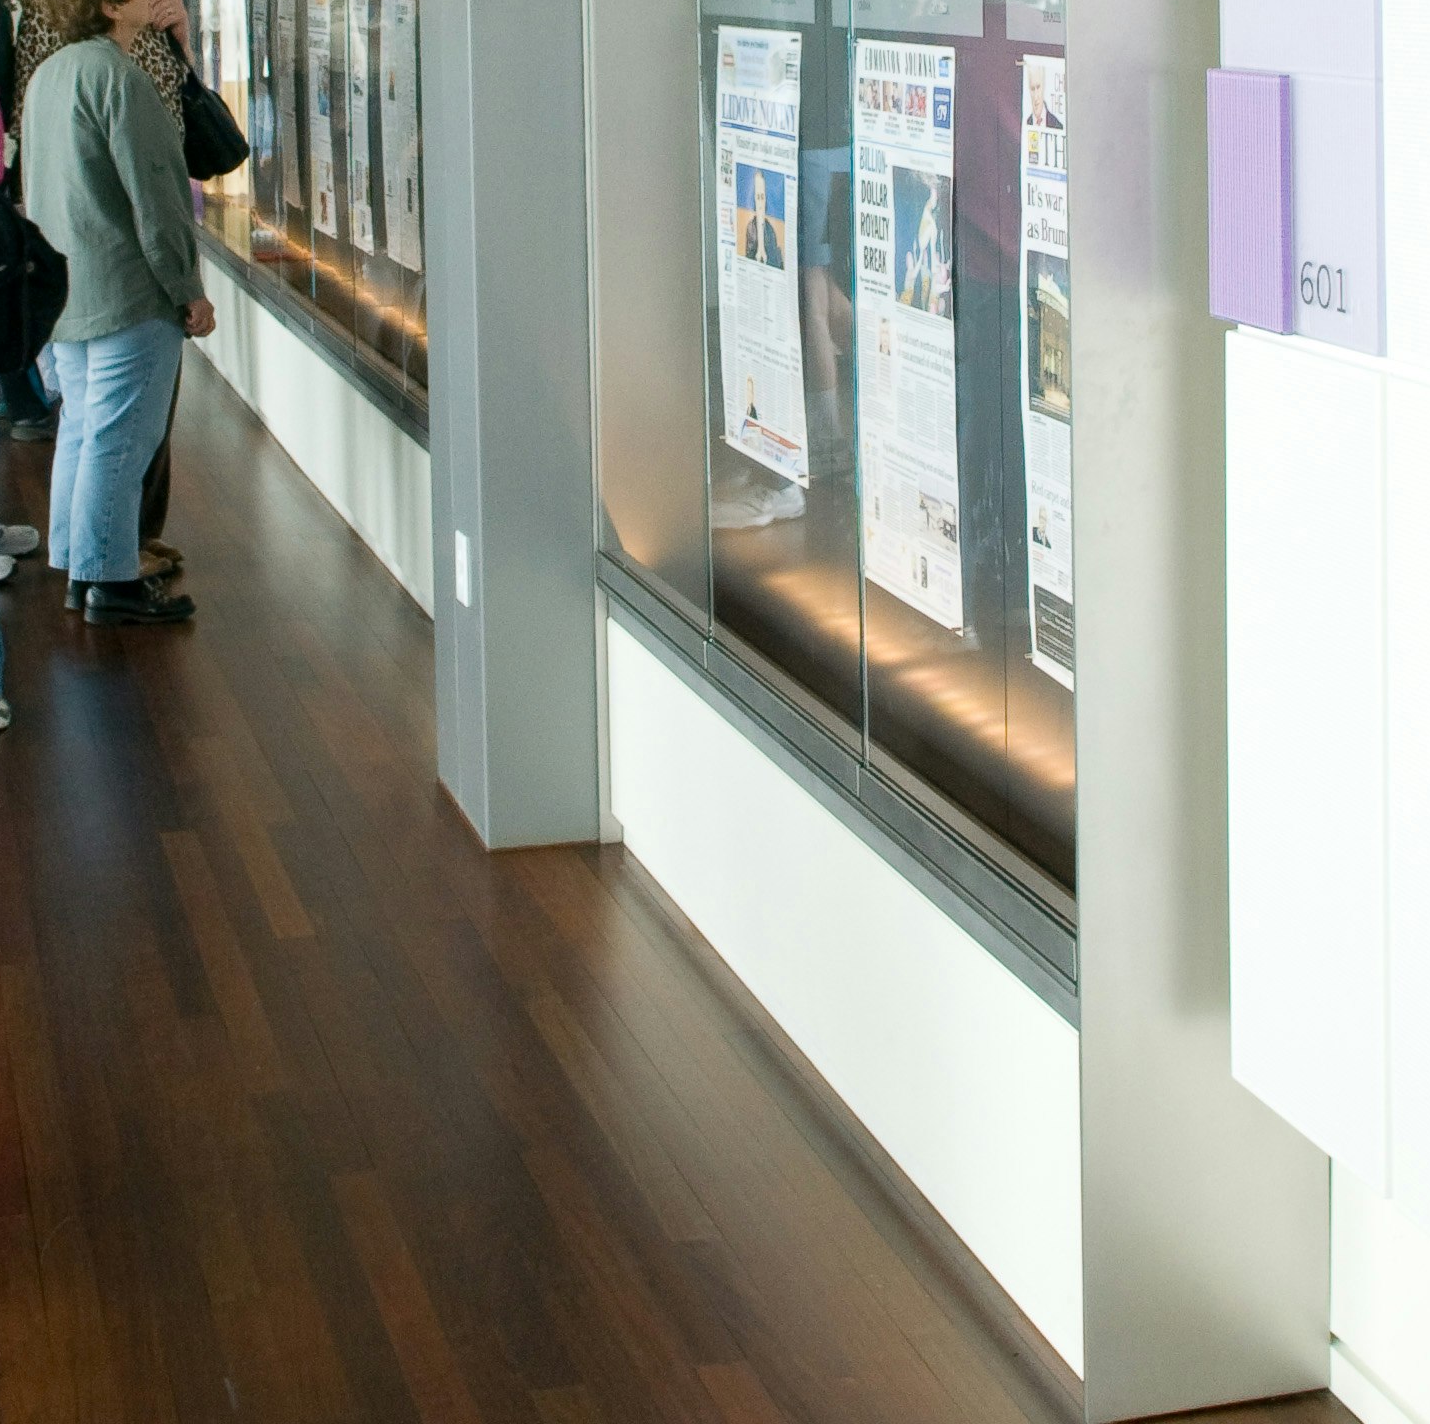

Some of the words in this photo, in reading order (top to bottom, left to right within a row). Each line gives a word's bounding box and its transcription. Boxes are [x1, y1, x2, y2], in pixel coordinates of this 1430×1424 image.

[864, 47, 901, 74] EDMONTON
[904, 52, 937, 79] JOURNAL
[860, 179, 888, 209] DOLLAR
[1027, 182, 1044, 208] It's
[860, 211, 890, 242] ROYALTY
[1026, 221, 1039, 239] as
[863, 245, 888, 275] BREAK
[1300, 260, 1347, 314] 601
